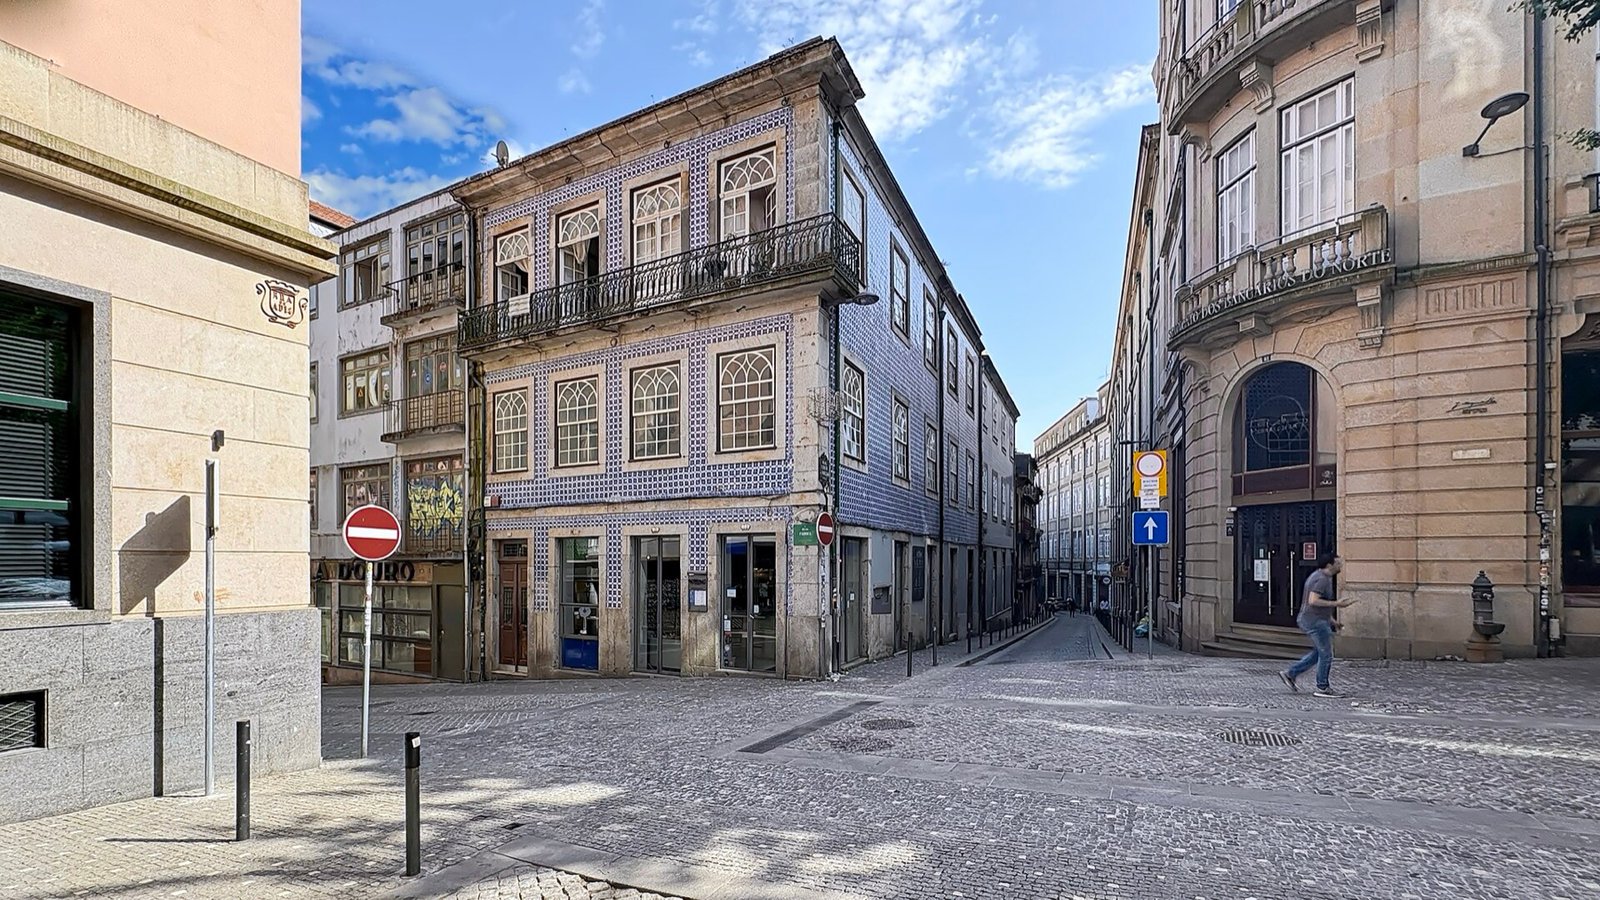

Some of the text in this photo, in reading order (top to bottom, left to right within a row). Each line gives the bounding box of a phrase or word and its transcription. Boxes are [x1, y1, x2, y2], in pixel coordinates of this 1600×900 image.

[1201, 302, 1221, 319] DOS
[1301, 267, 1326, 283] DO
[1331, 248, 1391, 275] NORTE
